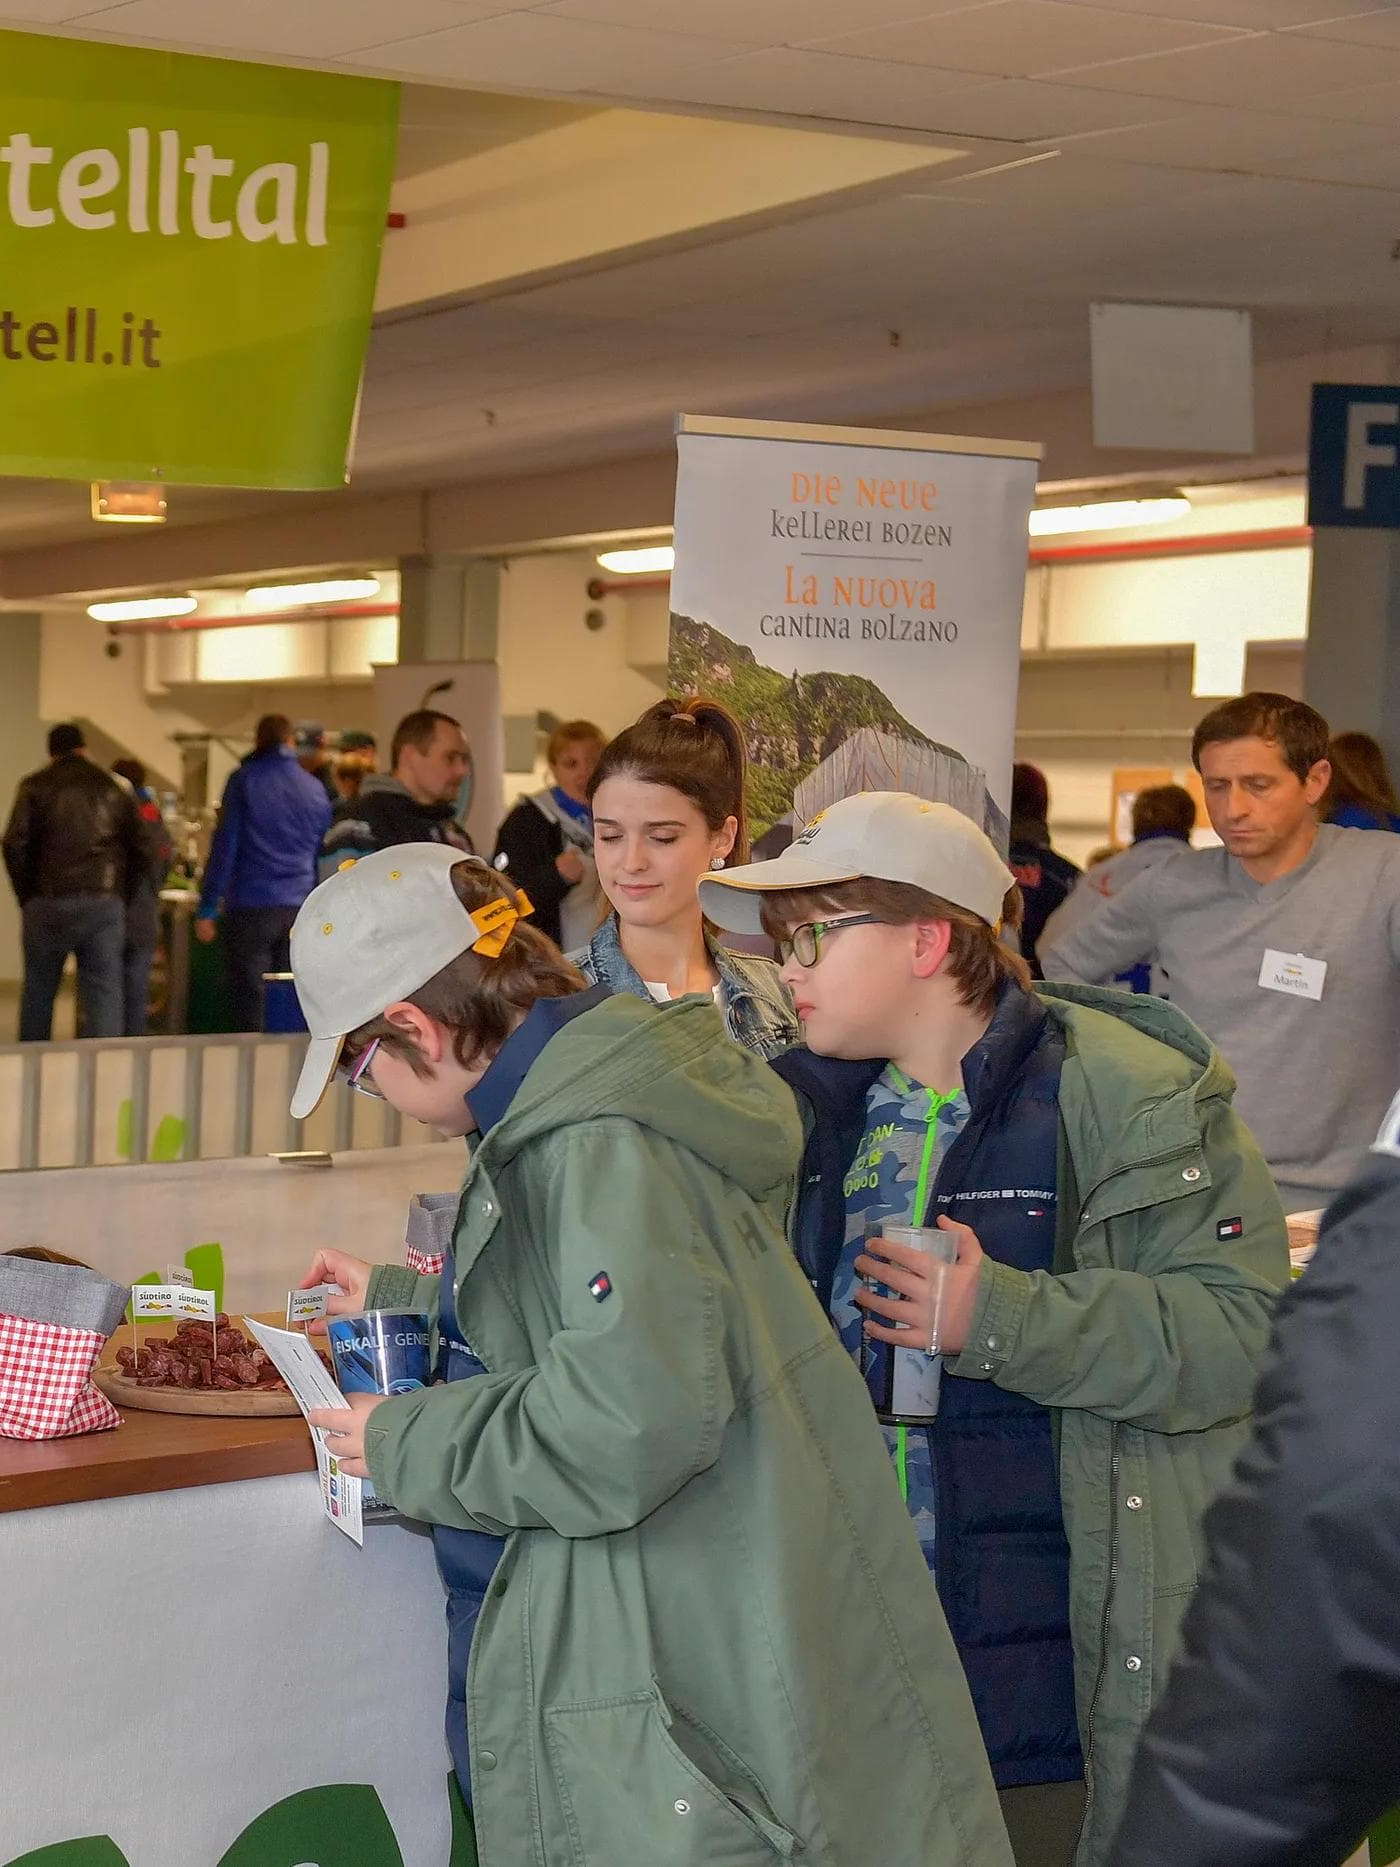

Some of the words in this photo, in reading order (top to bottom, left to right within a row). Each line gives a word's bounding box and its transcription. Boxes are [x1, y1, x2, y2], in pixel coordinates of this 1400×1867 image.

[1343, 401, 1399, 510] F
[1273, 973, 1309, 990] Martin
[955, 1190, 1001, 1201] HILFIGER
[1016, 1189, 1055, 1201] TOMMY
[335, 1333, 391, 1354] EISKALT
